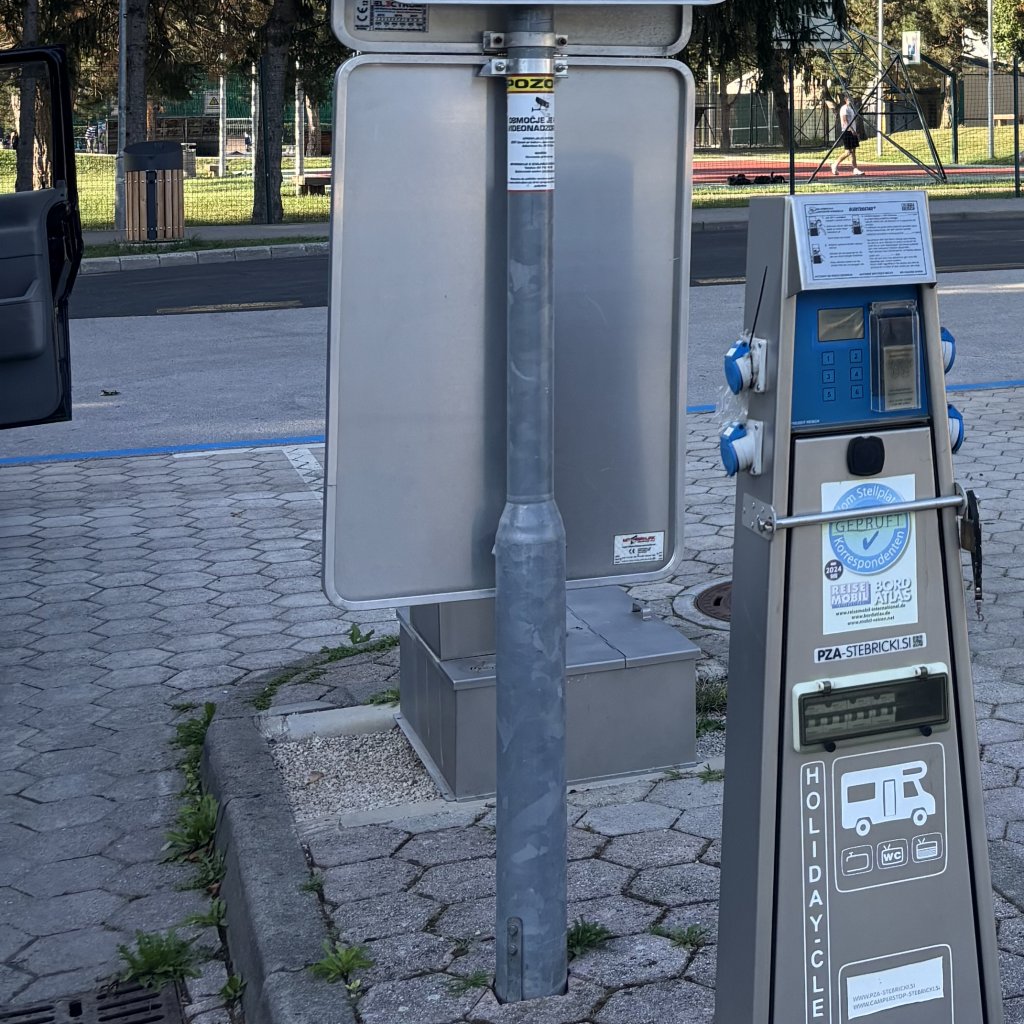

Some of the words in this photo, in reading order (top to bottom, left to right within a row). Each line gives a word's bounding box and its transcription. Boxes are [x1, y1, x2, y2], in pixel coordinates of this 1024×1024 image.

[833, 530, 905, 570] Korrespondenten
[825, 565, 842, 574] 2024
[831, 582, 866, 595] REISE
[876, 578, 912, 592] BORD
[831, 593, 869, 605] MOBIL
[875, 589, 912, 605] ATLAS
[817, 636, 912, 662] PZA-STEBRICKI.SI
[883, 851, 902, 863] WC
